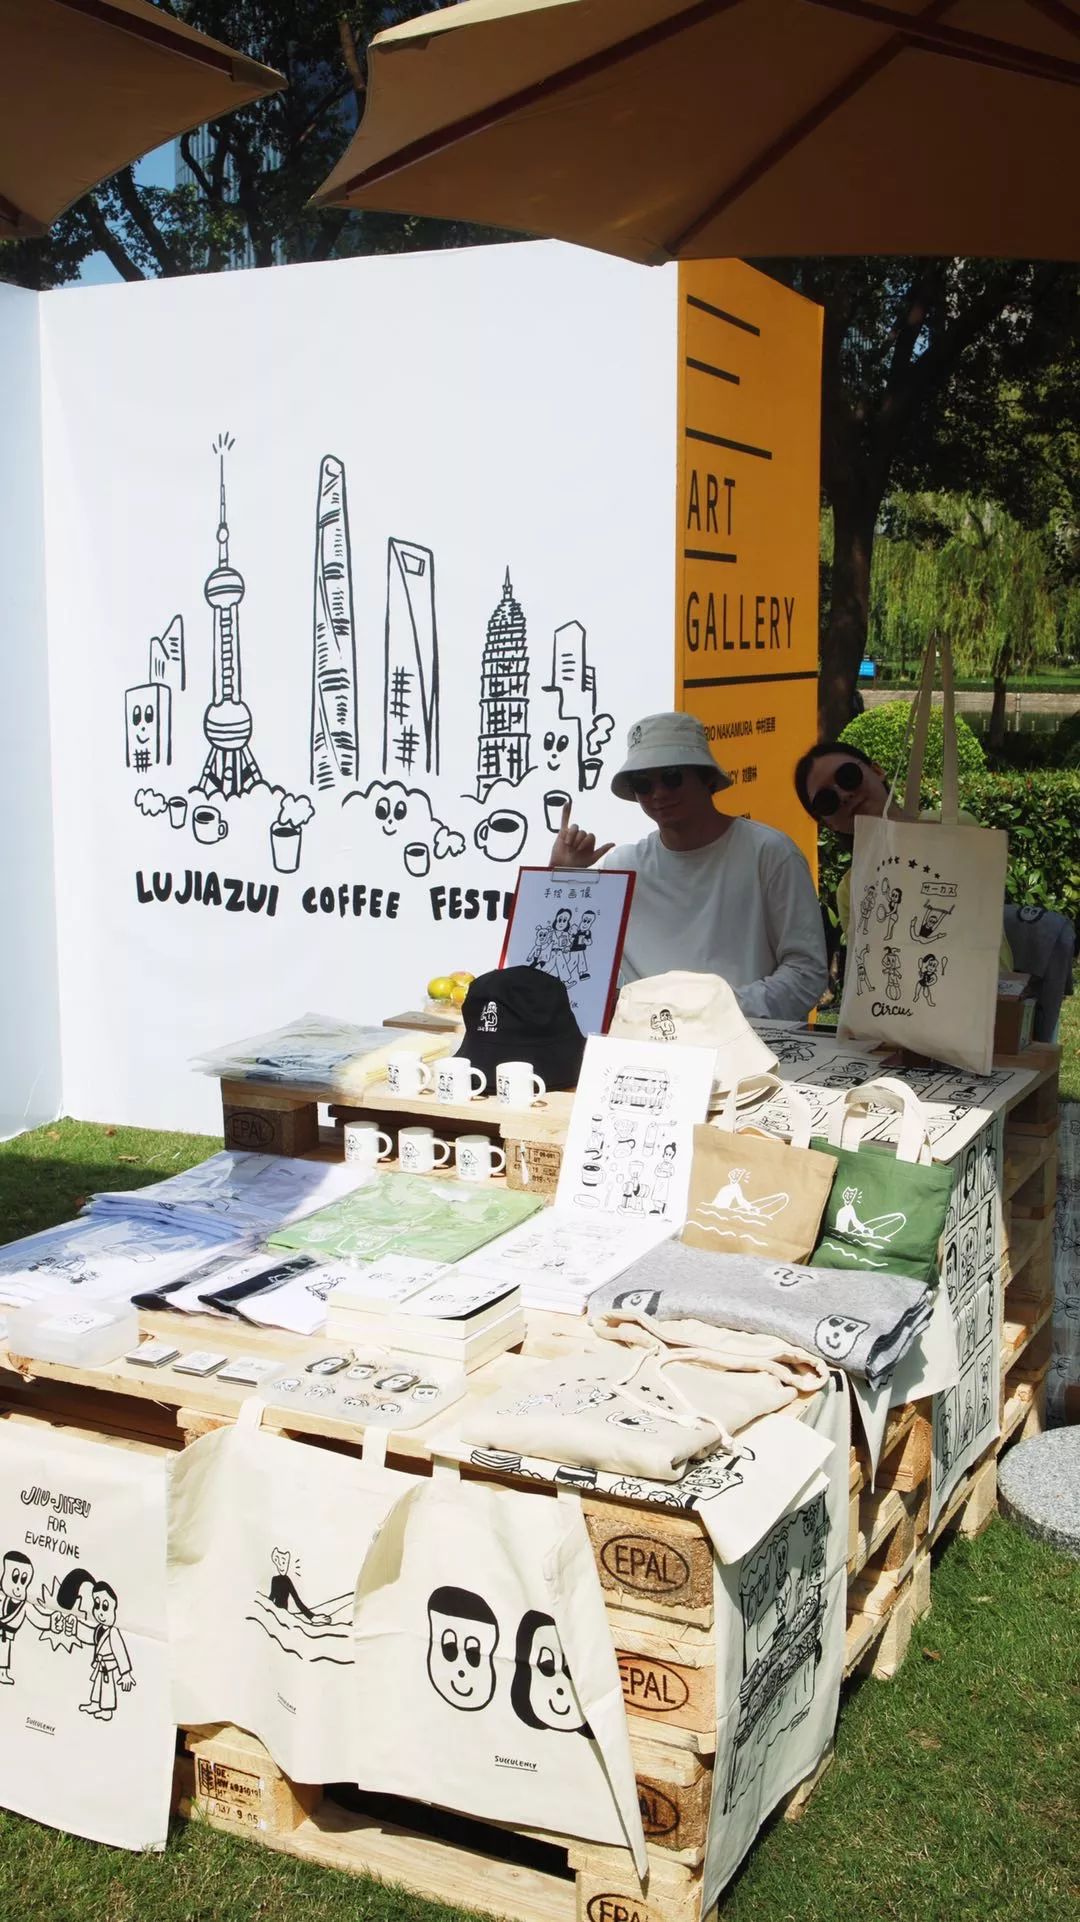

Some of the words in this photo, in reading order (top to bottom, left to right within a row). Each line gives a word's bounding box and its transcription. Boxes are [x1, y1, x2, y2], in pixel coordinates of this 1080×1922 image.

[687, 469, 737, 536] ART
[686, 591, 797, 652] GALLERY
[716, 720, 753, 740] NAKAMURA
[136, 869, 280, 917] LUJIAZUI
[302, 884, 401, 919] COFFEE
[924, 884, 954, 895] サーカス
[871, 1002, 914, 1017] Circus
[231, 1118, 272, 1143] EPAL
[20, 1486, 92, 1519] JIU-JITSU
[47, 1515, 67, 1534] FOR
[614, 1545, 678, 1585] EPAL
[599, 1900, 650, 1922] EP
